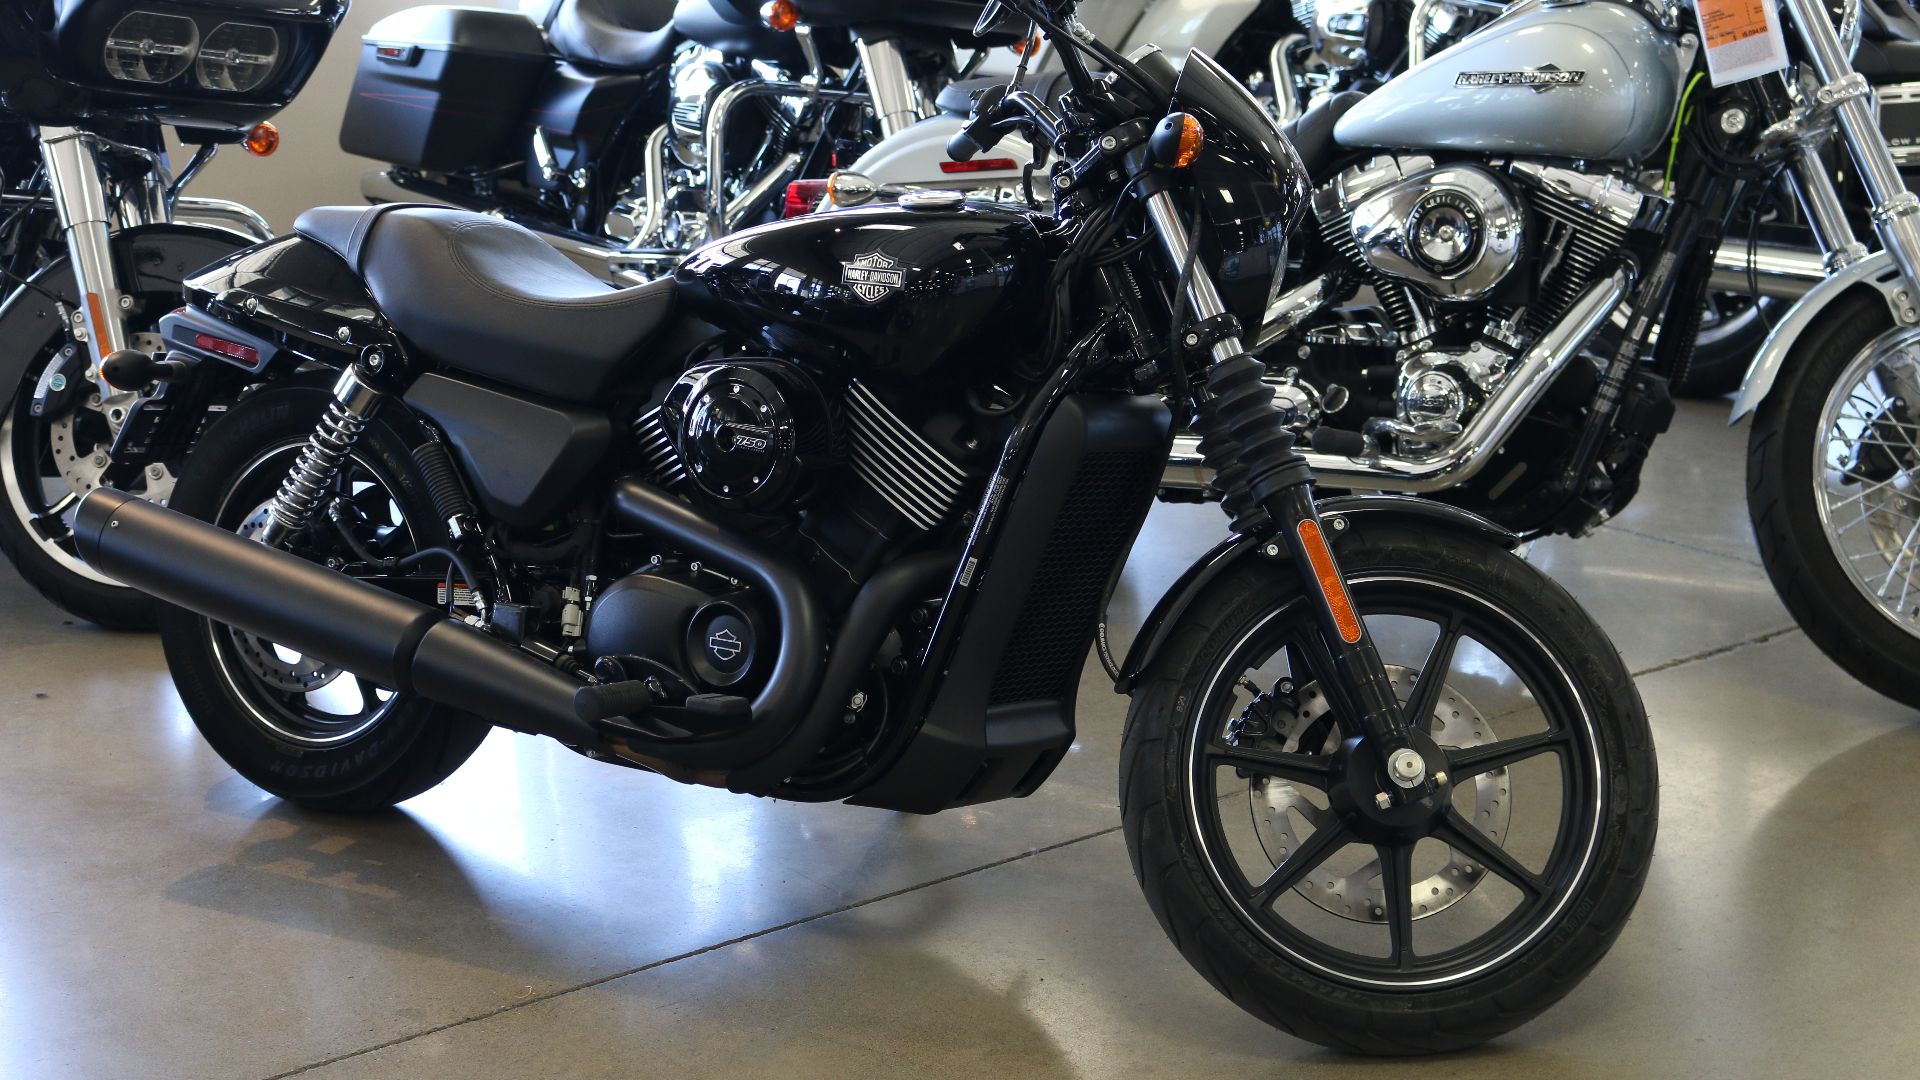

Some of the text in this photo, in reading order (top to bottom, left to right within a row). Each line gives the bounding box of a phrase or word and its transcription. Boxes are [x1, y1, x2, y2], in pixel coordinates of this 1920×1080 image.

[1458, 72, 1580, 85] HARLEY-DAVIDSON
[862, 255, 889, 269] MOTOR
[847, 268, 900, 285] HARLEY-DAVIDSON
[857, 283, 885, 299] CYCLES
[736, 434, 767, 450] 750
